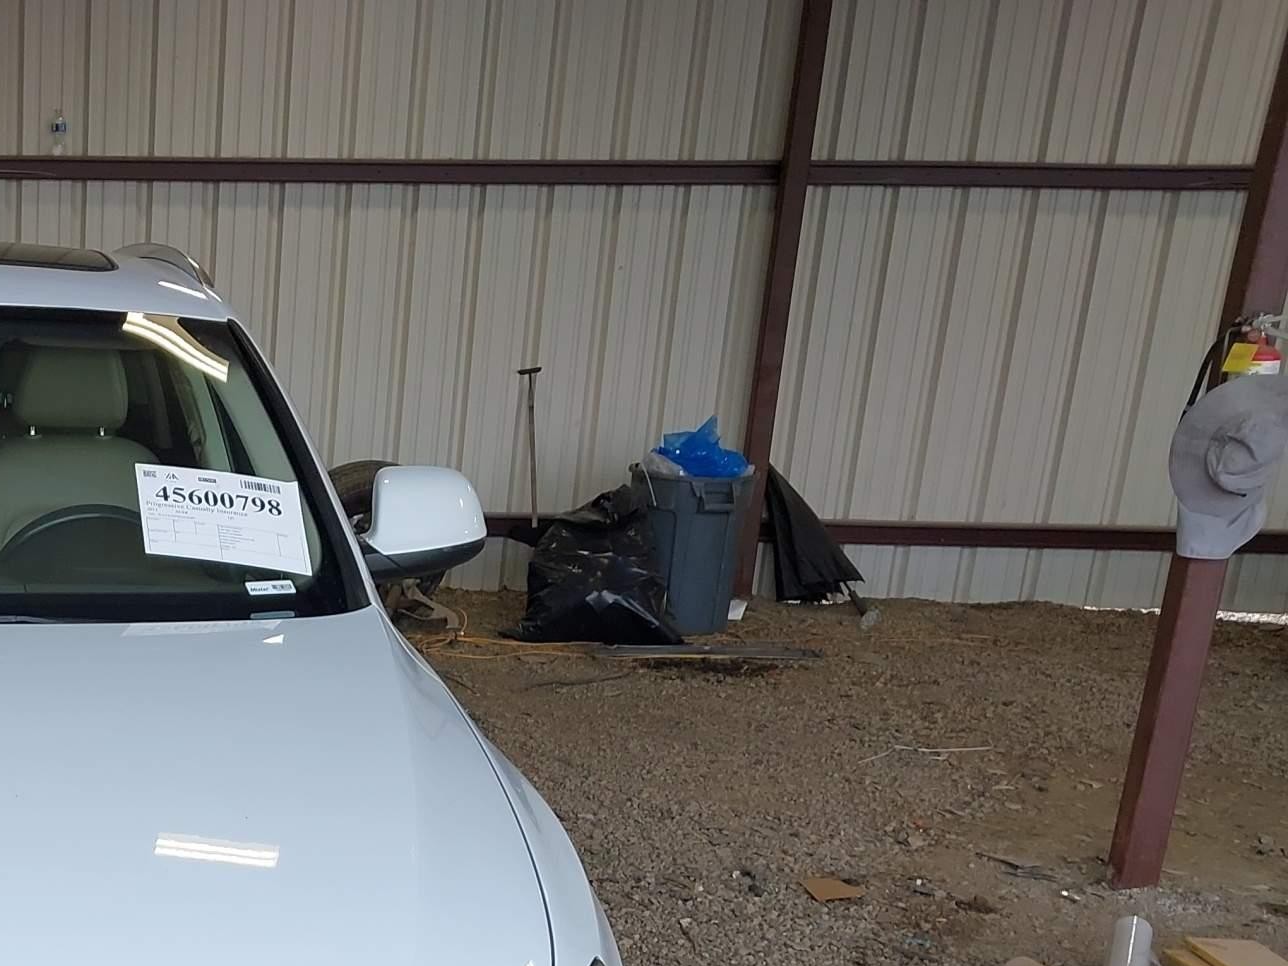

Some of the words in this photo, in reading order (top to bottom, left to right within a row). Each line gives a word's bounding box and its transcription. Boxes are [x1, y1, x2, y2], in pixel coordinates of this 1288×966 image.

[146, 501, 184, 510] Progressive
[185, 504, 214, 514] Casualty
[216, 507, 248, 517] Insurance
[155, 486, 282, 516] 45600798
